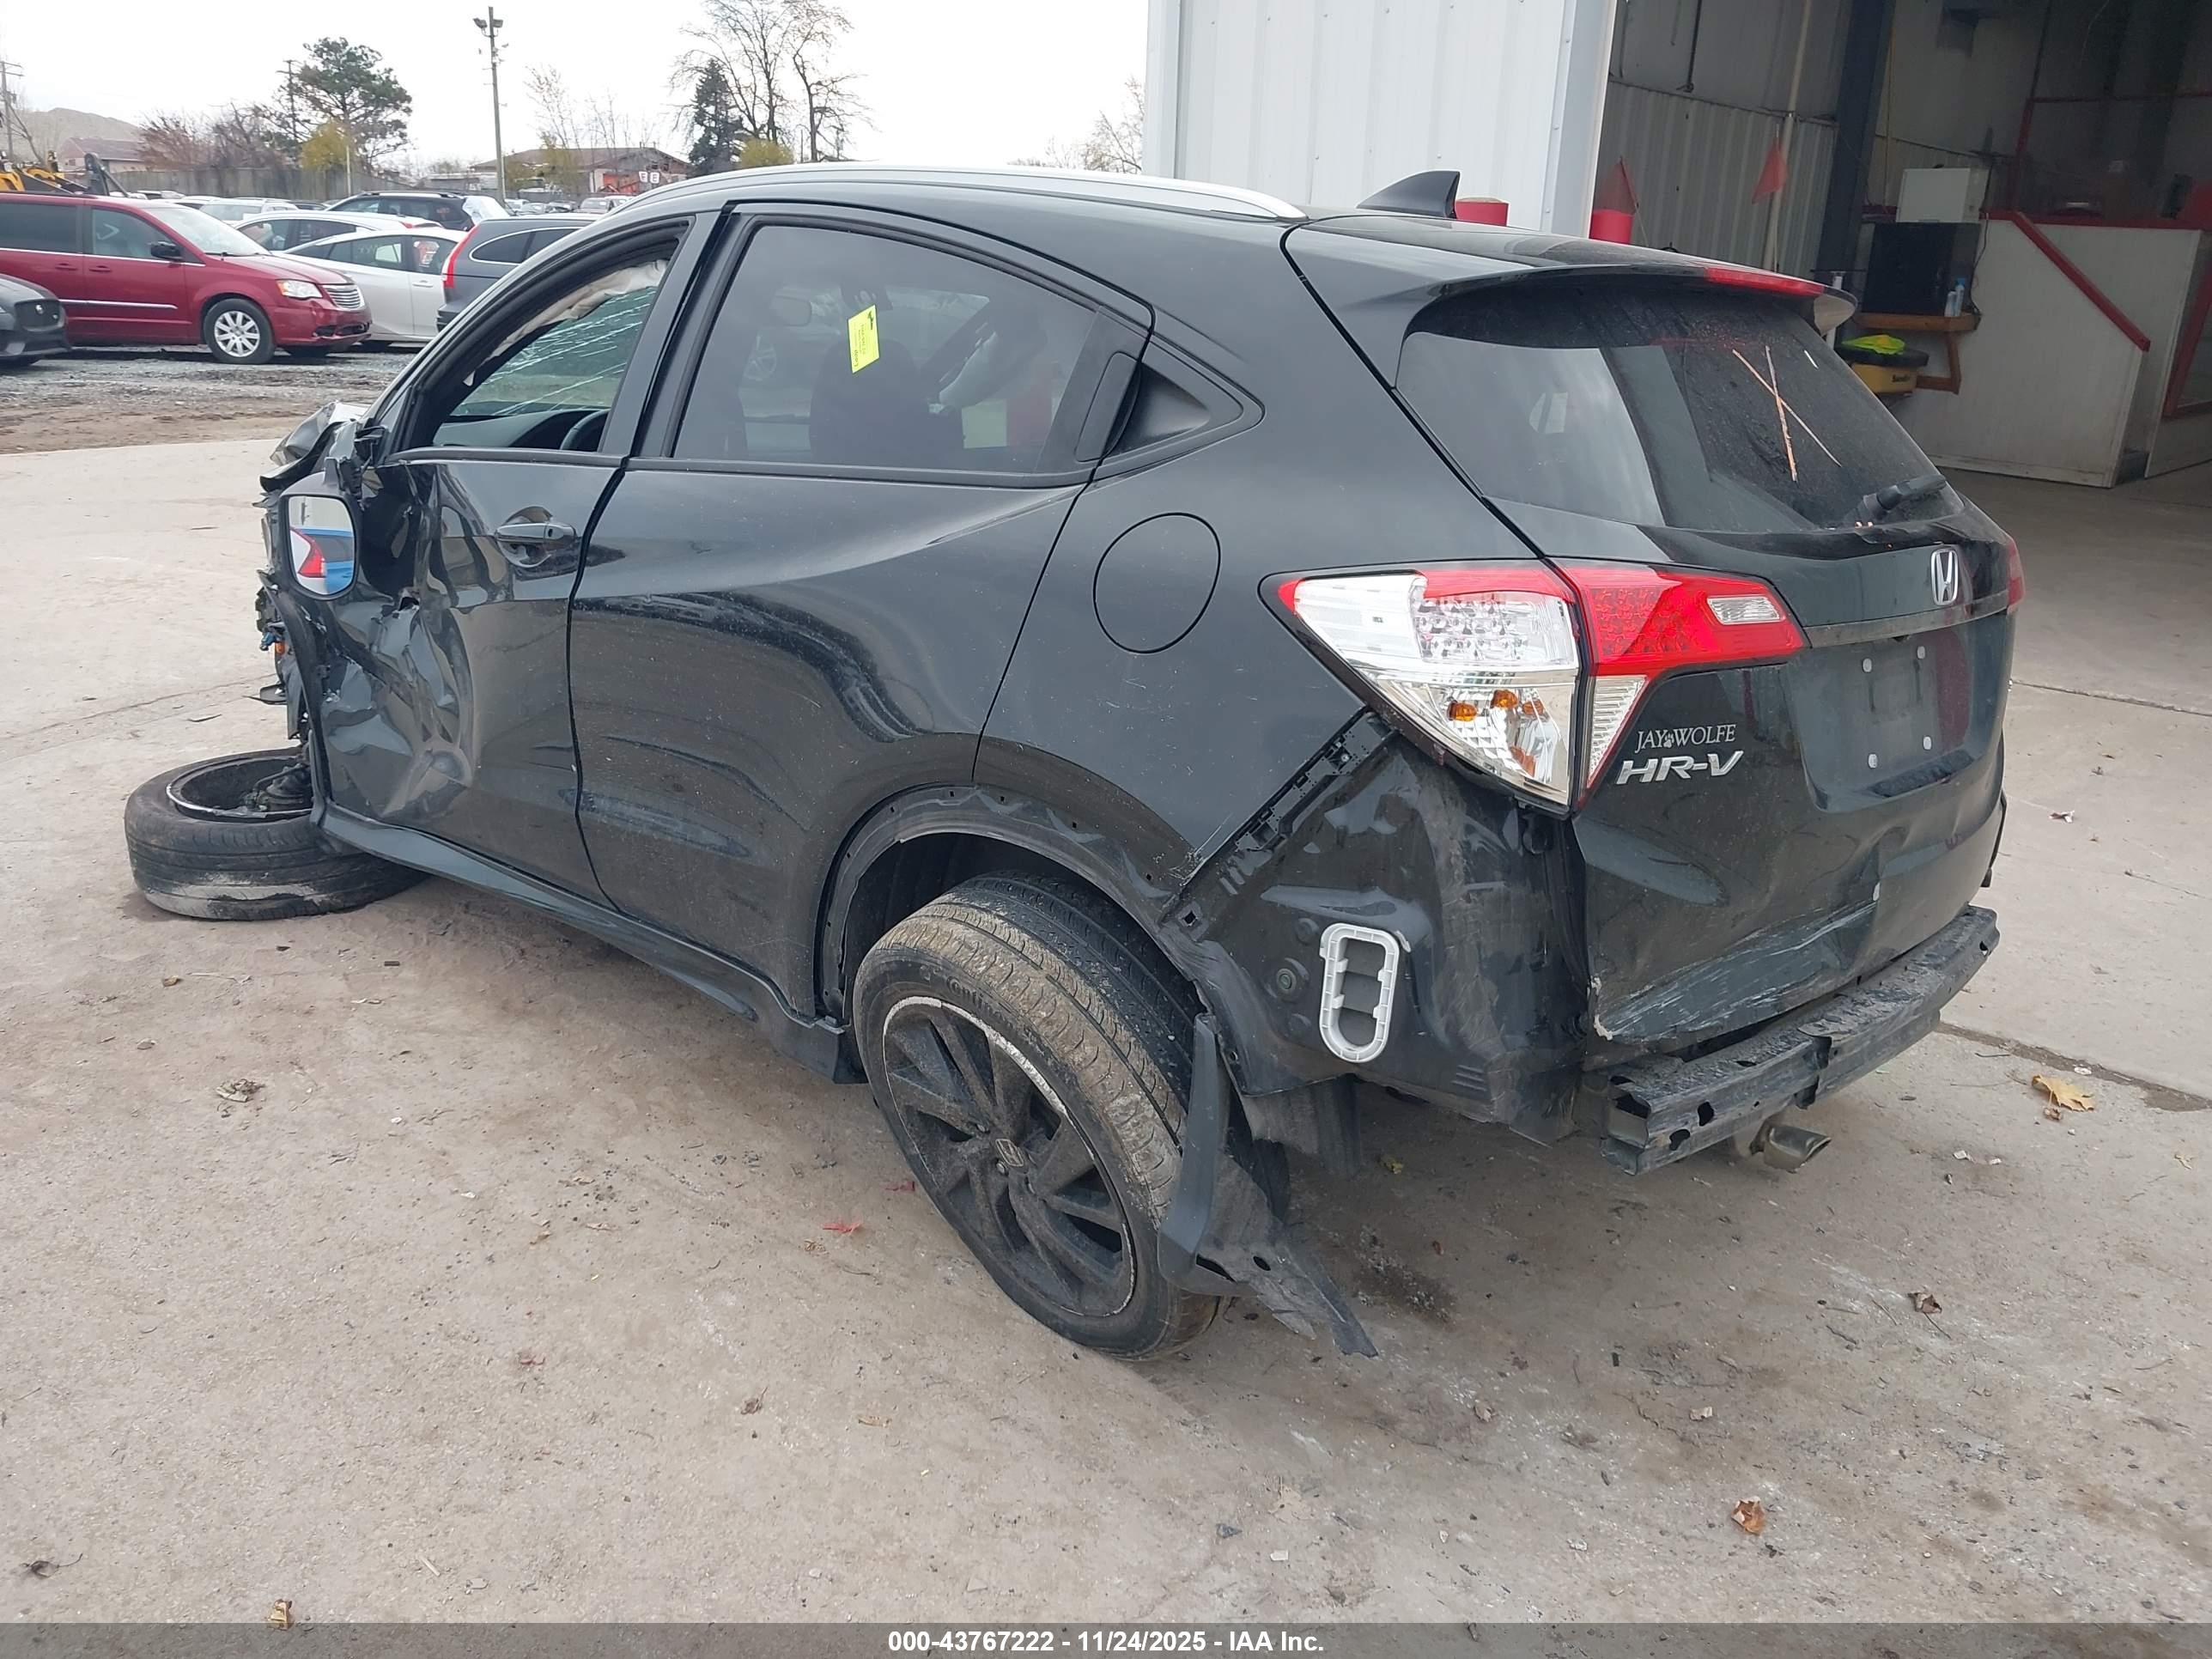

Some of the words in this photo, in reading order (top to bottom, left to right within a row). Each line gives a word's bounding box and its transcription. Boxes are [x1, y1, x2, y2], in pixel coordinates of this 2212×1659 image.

[1635, 729, 1668, 754] JAY
[1672, 724, 1737, 747] WOLFE
[1616, 750, 1744, 785] HR-V
